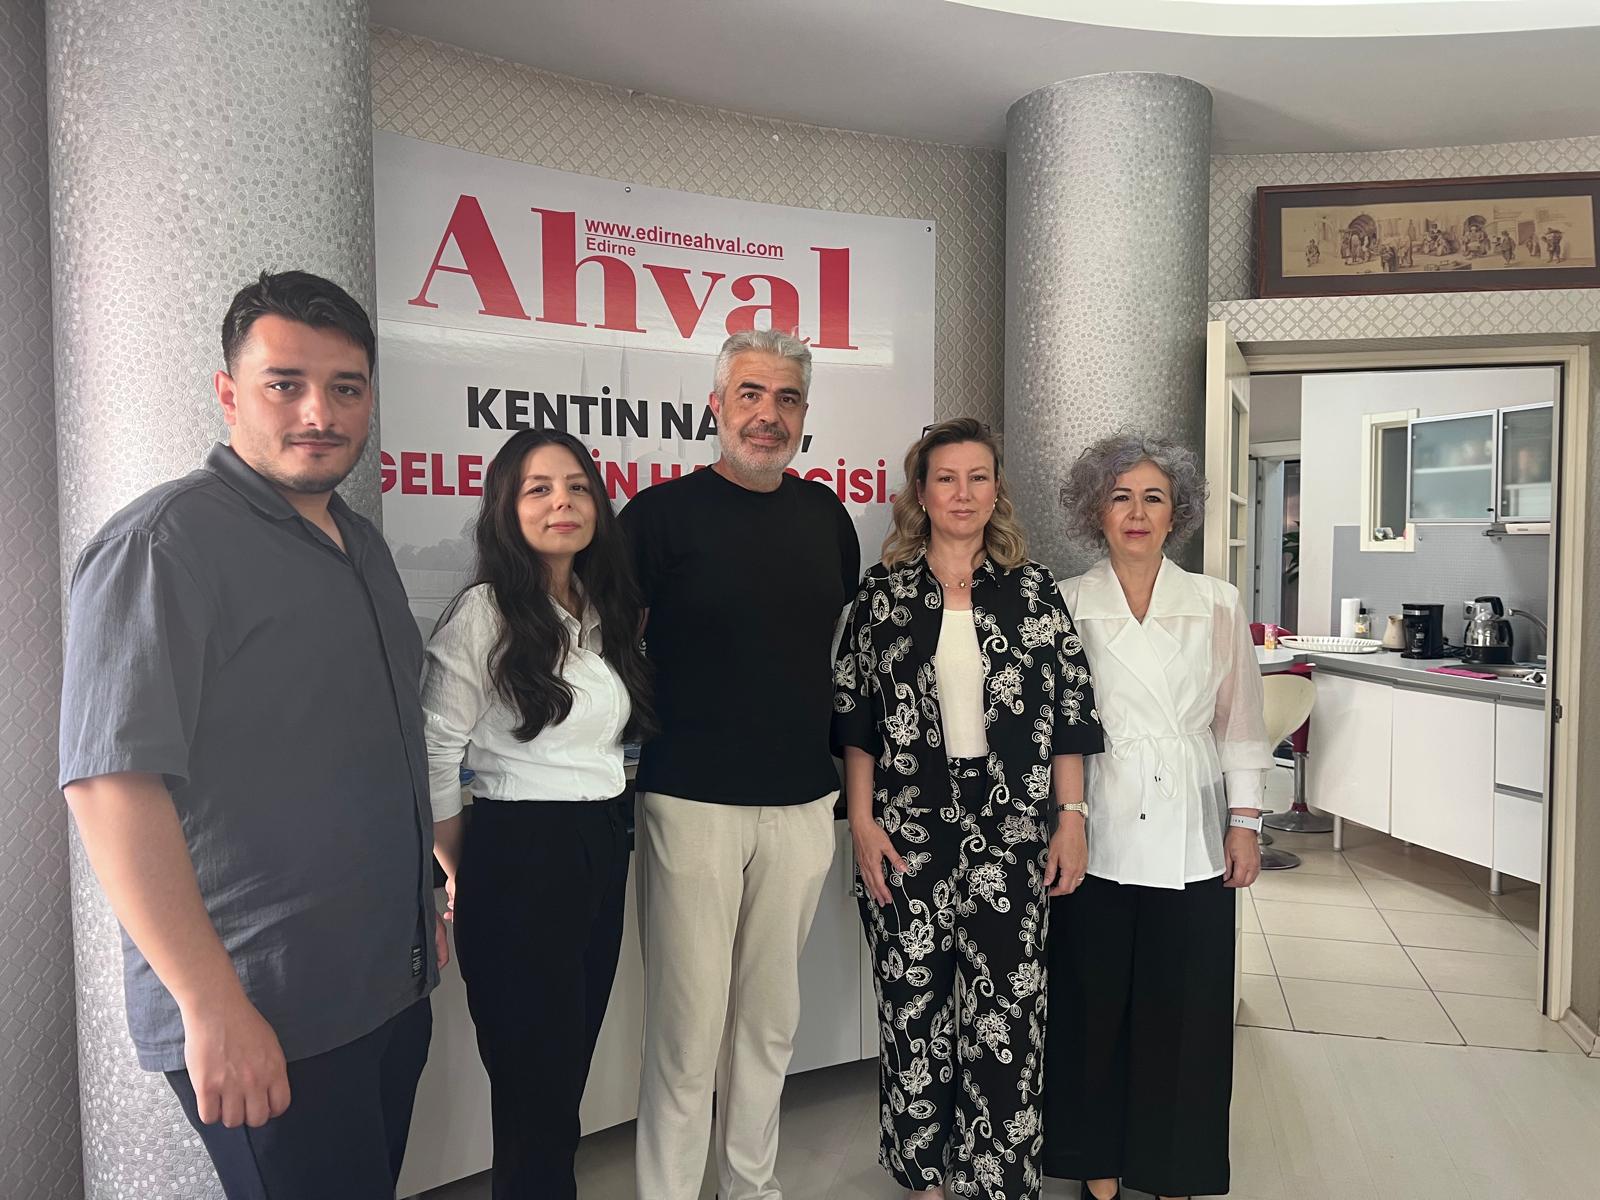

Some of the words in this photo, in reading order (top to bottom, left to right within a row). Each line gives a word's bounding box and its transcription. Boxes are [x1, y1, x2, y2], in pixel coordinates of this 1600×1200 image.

[585, 219, 784, 258] www.edirneahval.com
[586, 237, 636, 256] Edirne
[408, 194, 858, 350] Ahval
[467, 386, 649, 438] KENTİN
[661, 401, 813, 453] NA,
